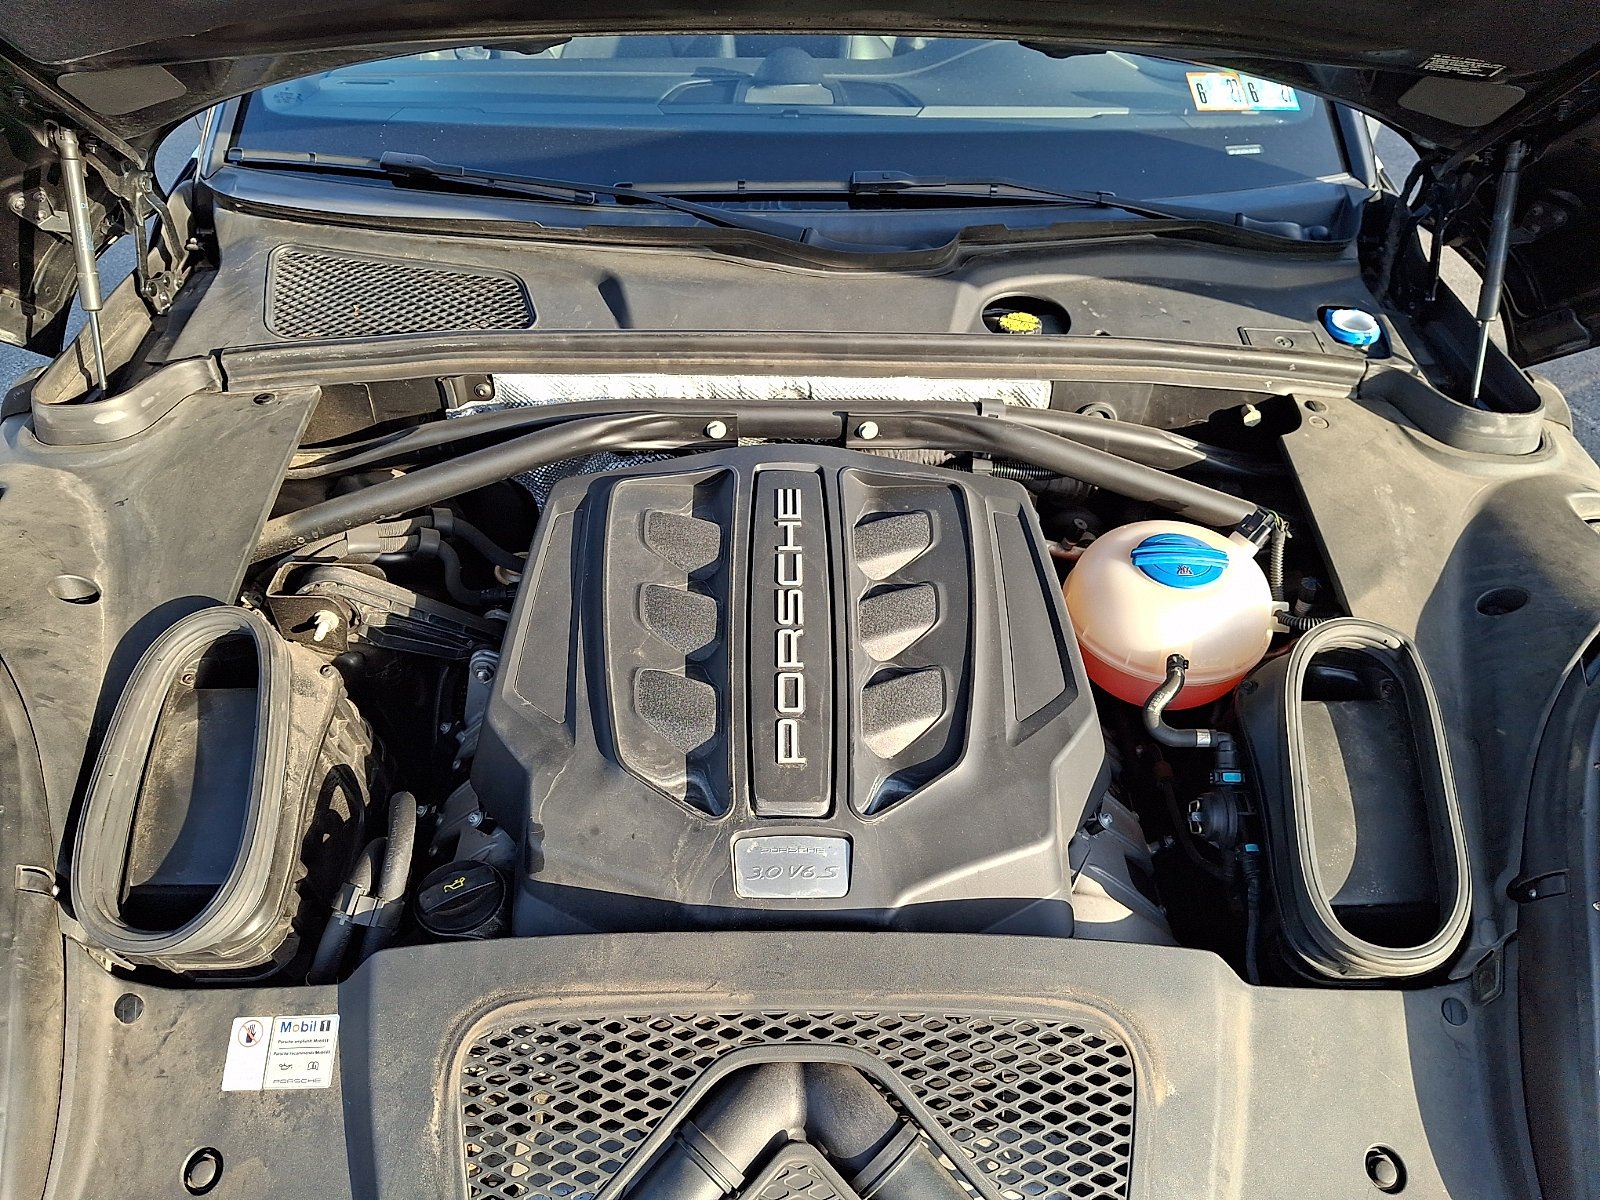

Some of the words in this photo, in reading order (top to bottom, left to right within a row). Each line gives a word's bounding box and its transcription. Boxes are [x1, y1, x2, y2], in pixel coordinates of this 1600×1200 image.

[1196, 83, 1208, 104] 6
[1247, 82, 1260, 103] 6
[776, 488, 807, 766] PORSCHE
[760, 846, 825, 855] PORSCHE
[746, 865, 784, 880] 3.0
[788, 864, 817, 880] V6
[816, 865, 841, 880] S
[280, 1020, 317, 1033] Mobil
[319, 1020, 331, 1032] 1
